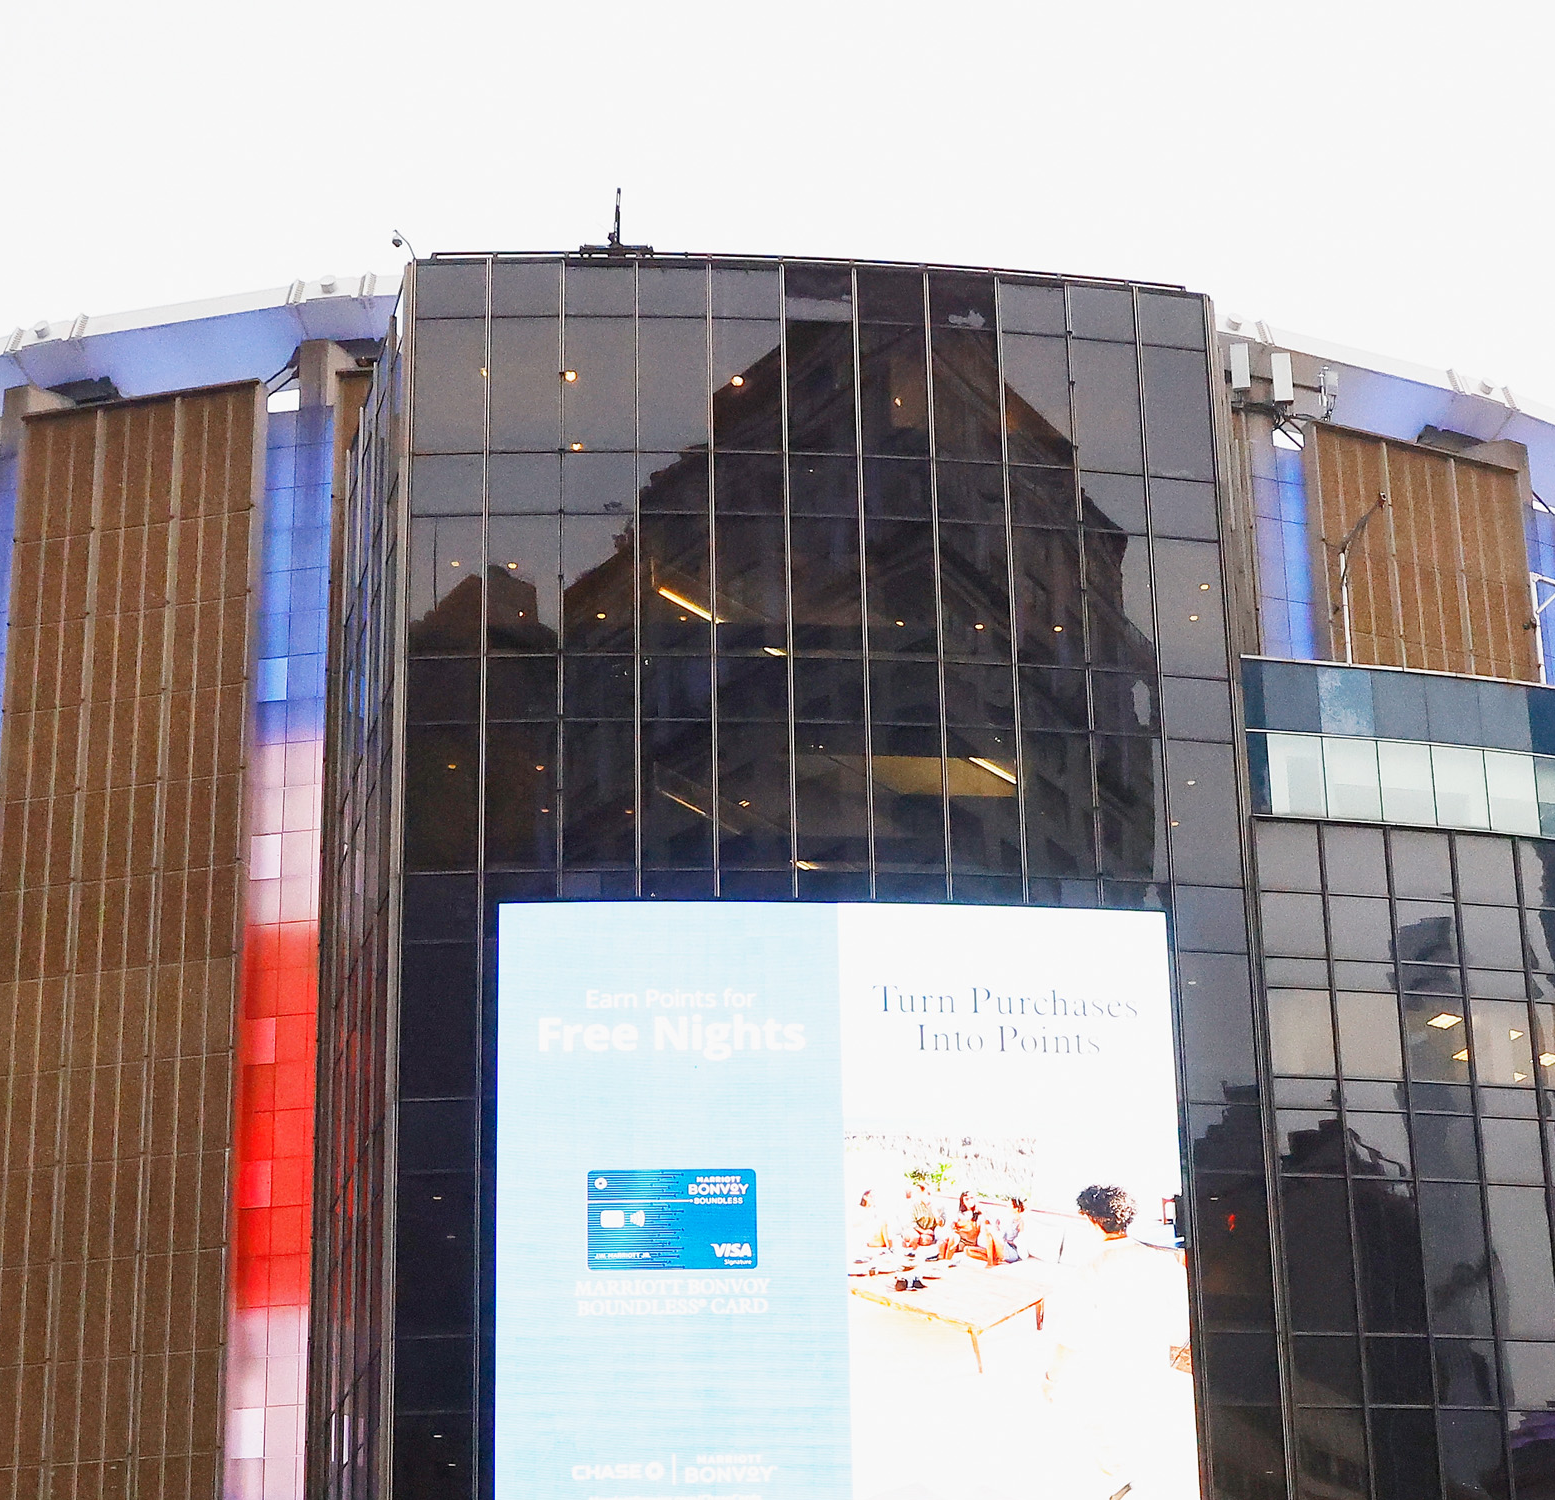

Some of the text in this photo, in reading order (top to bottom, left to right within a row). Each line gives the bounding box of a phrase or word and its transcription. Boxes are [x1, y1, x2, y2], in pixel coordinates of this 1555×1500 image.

[585, 987, 757, 1009] Earn Points for
[872, 984, 1138, 1018] Turn Purchases
[538, 1013, 807, 1062] Free Nights
[917, 1023, 1101, 1055] Into Points
[695, 1175, 742, 1183] MARRIOTT
[687, 1182, 749, 1196] BONVOY
[710, 1242, 753, 1258] VISA
[723, 1258, 753, 1266] Signature
[574, 1277, 772, 1297] MARRIOTT BONVOY
[710, 1298, 769, 1315] CARD
[695, 1453, 763, 1465] MARRIOTT
[570, 1463, 643, 1482] CHASE
[684, 1465, 773, 1485] BONVOY
